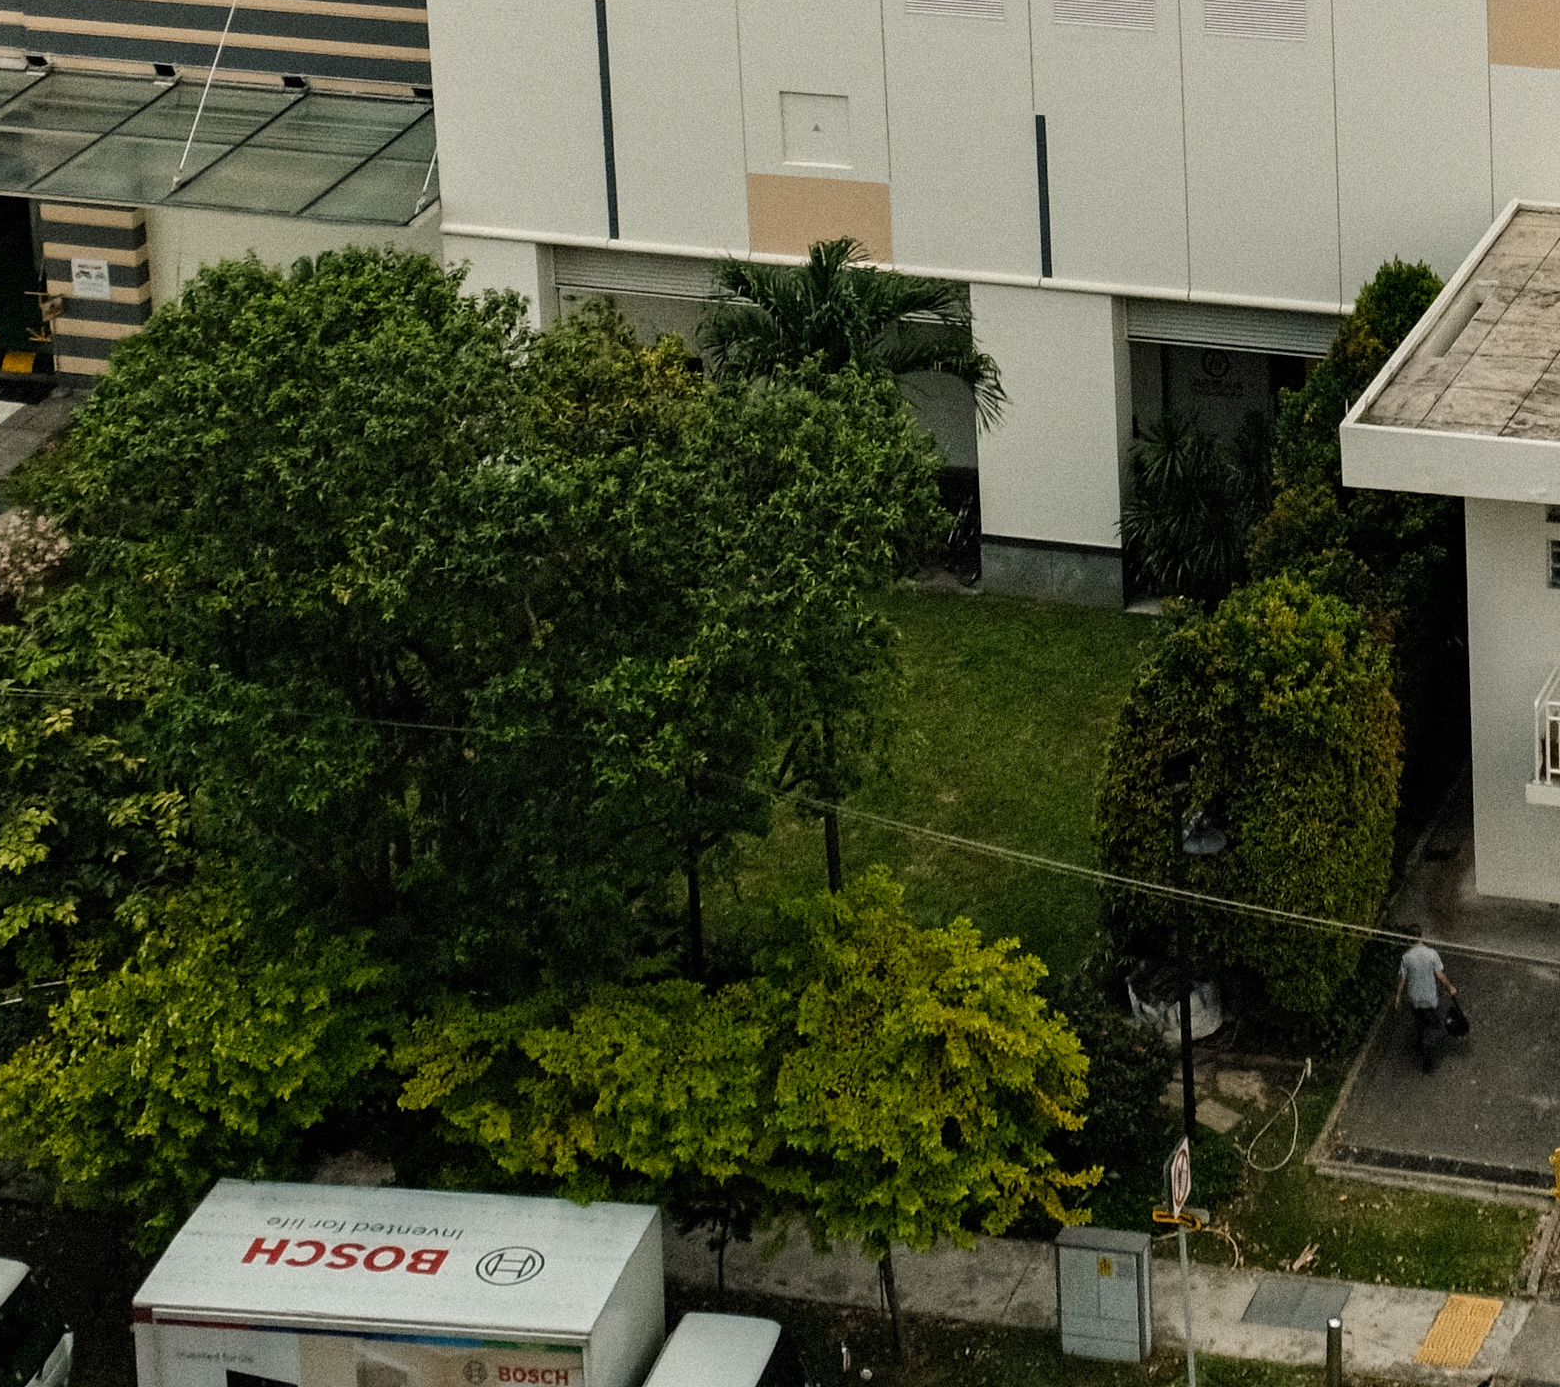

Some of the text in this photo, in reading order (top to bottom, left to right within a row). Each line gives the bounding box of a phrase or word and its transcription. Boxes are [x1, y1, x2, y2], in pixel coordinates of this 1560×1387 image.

[267, 1215, 464, 1241] Invented for life
[242, 1237, 450, 1276] BOSCH
[498, 1365, 569, 1386] BOSCH
